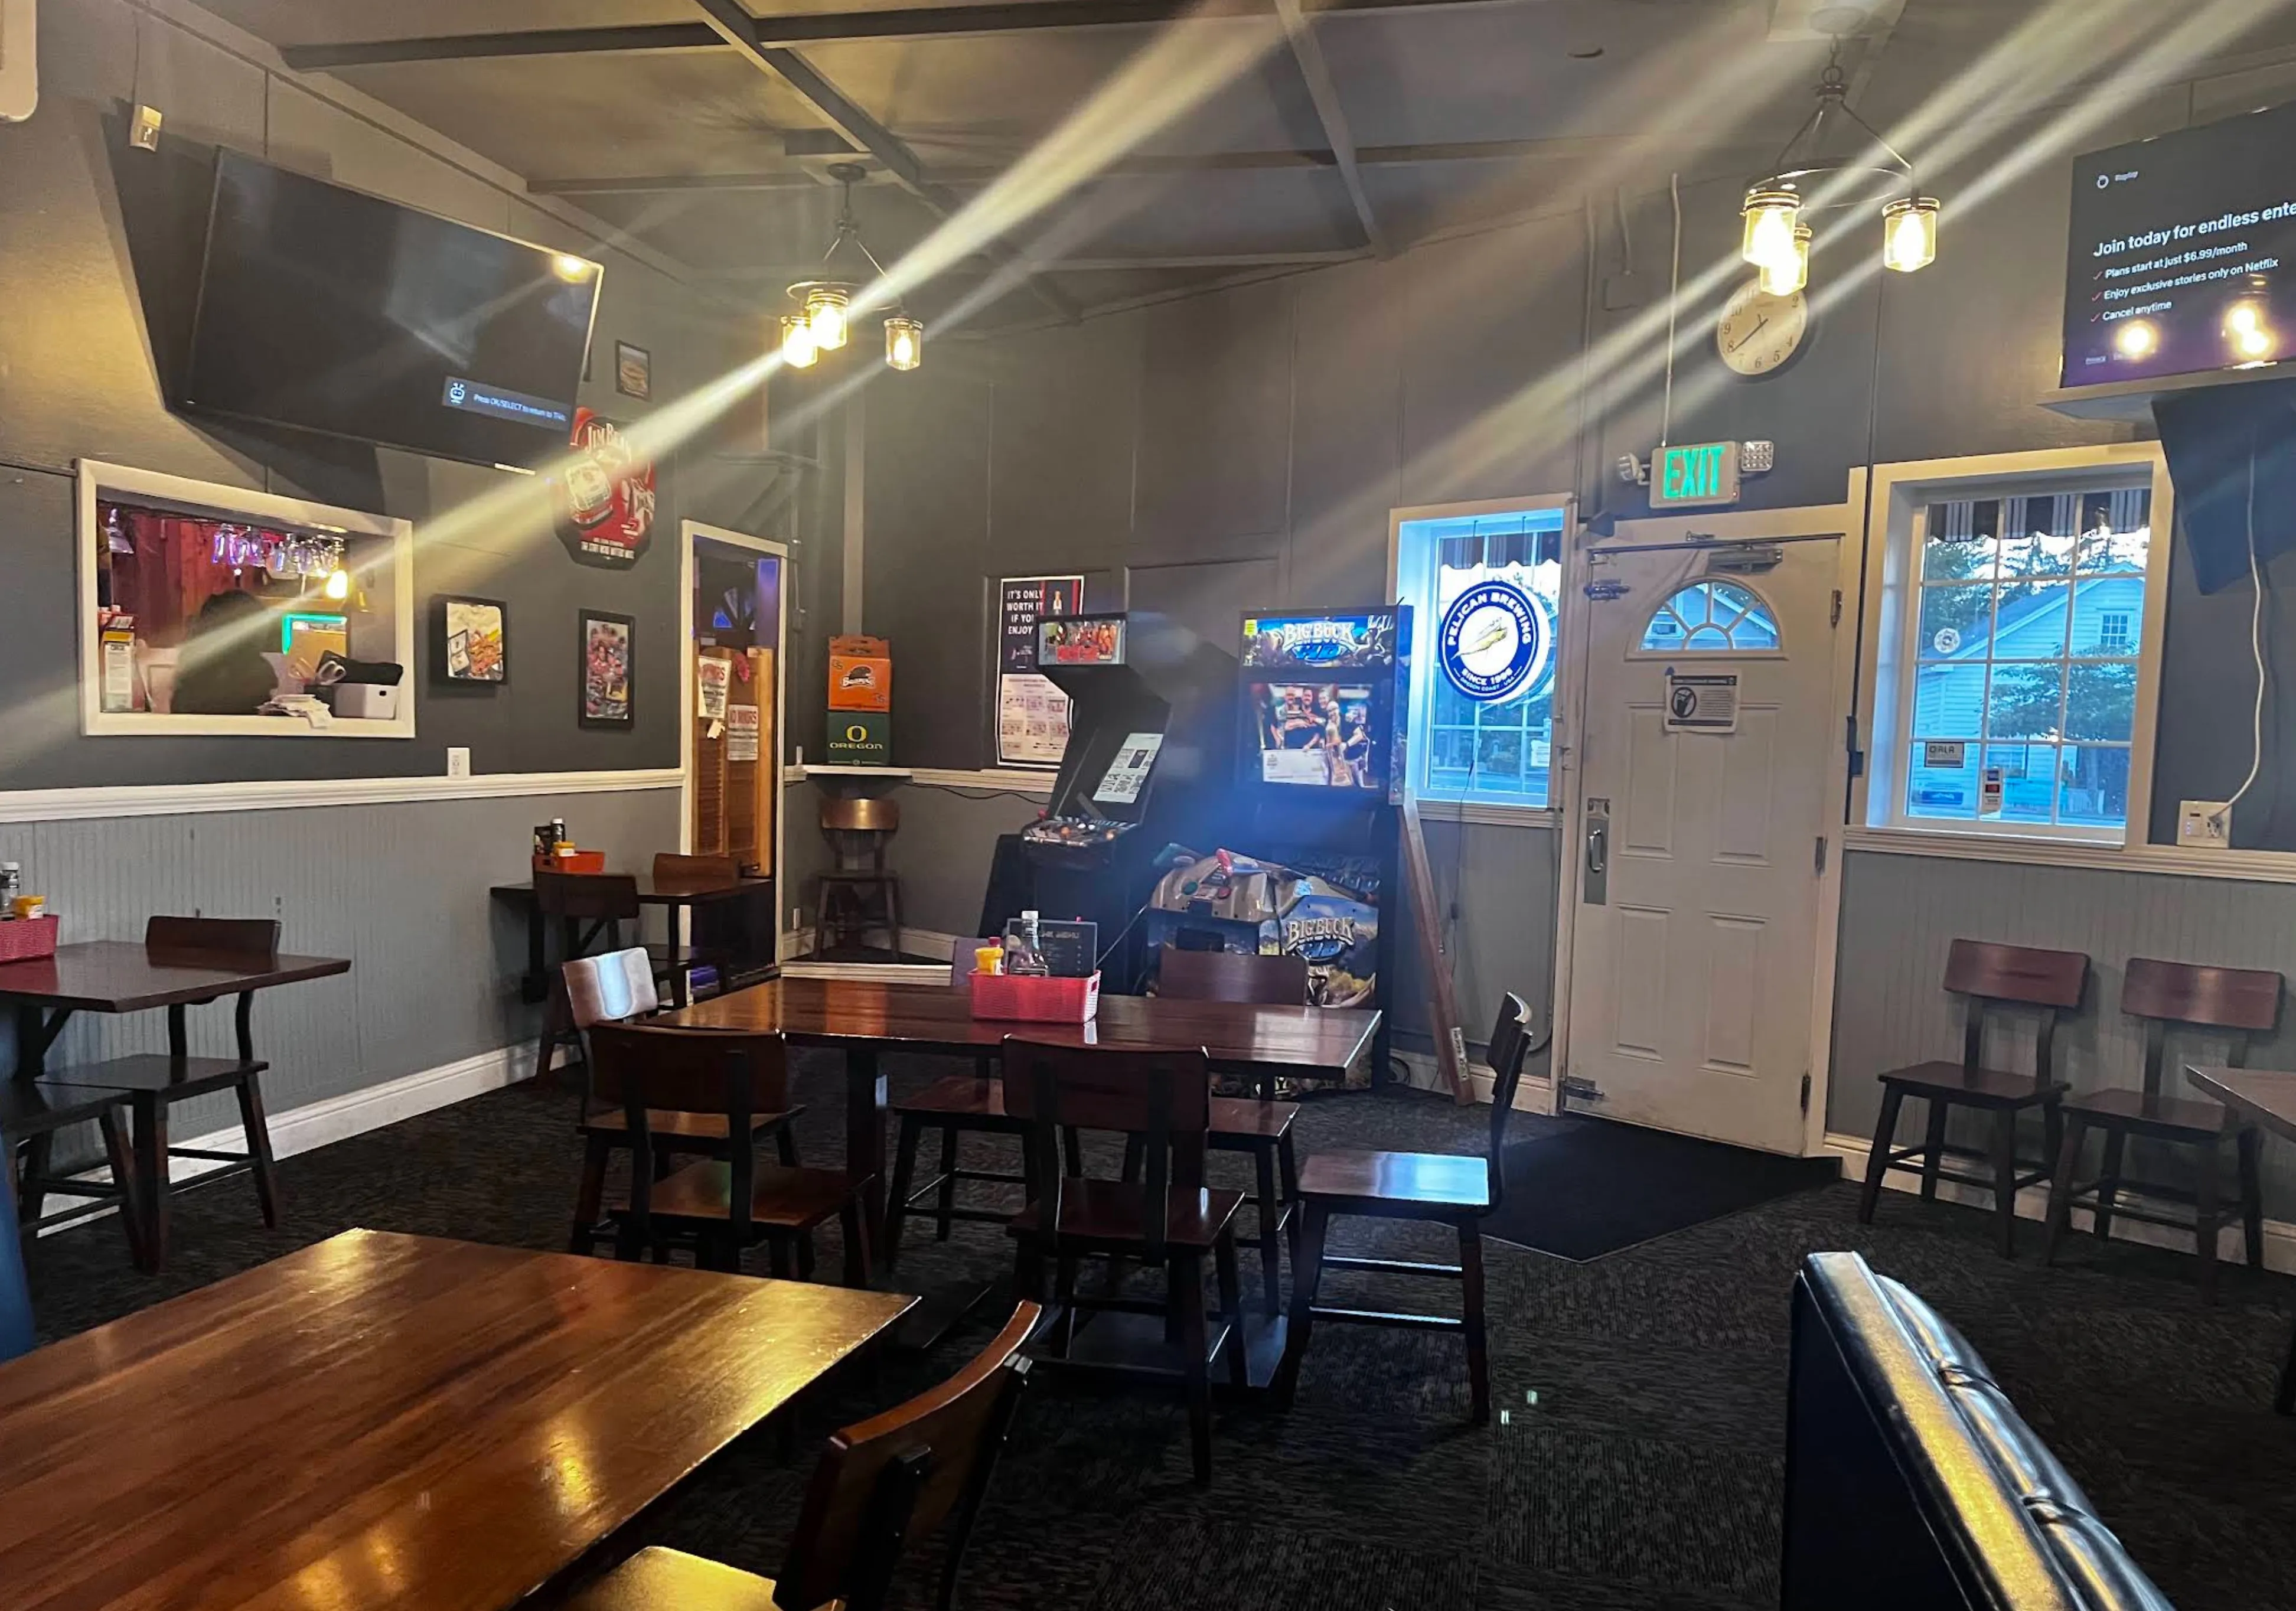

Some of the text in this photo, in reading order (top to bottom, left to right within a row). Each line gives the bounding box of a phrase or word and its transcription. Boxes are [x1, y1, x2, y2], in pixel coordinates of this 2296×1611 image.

[2093, 239, 2125, 256] Join
[2128, 230, 2171, 249] today
[2173, 224, 2196, 239] for
[2198, 211, 2259, 234] endless
[2105, 241, 2248, 279] Plans start at just $6.99/month
[2103, 257, 2279, 300] Enjoy exclusive stories only on Netflix
[2102, 301, 2172, 321] Cancel anytime
[1664, 446, 1728, 499] EXIT
[1006, 602, 1043, 611] WORTH IT
[1007, 589, 1044, 599] IT'S ONLY
[1007, 626, 1033, 635] ENJOY
[1447, 592, 1531, 646] PELICAN BREWING
[1282, 622, 1312, 650] BIG
[1313, 621, 1358, 650] BUCK
[1462, 668, 1488, 686] SINCE
[1287, 917, 1355, 946] BIG BUCK
